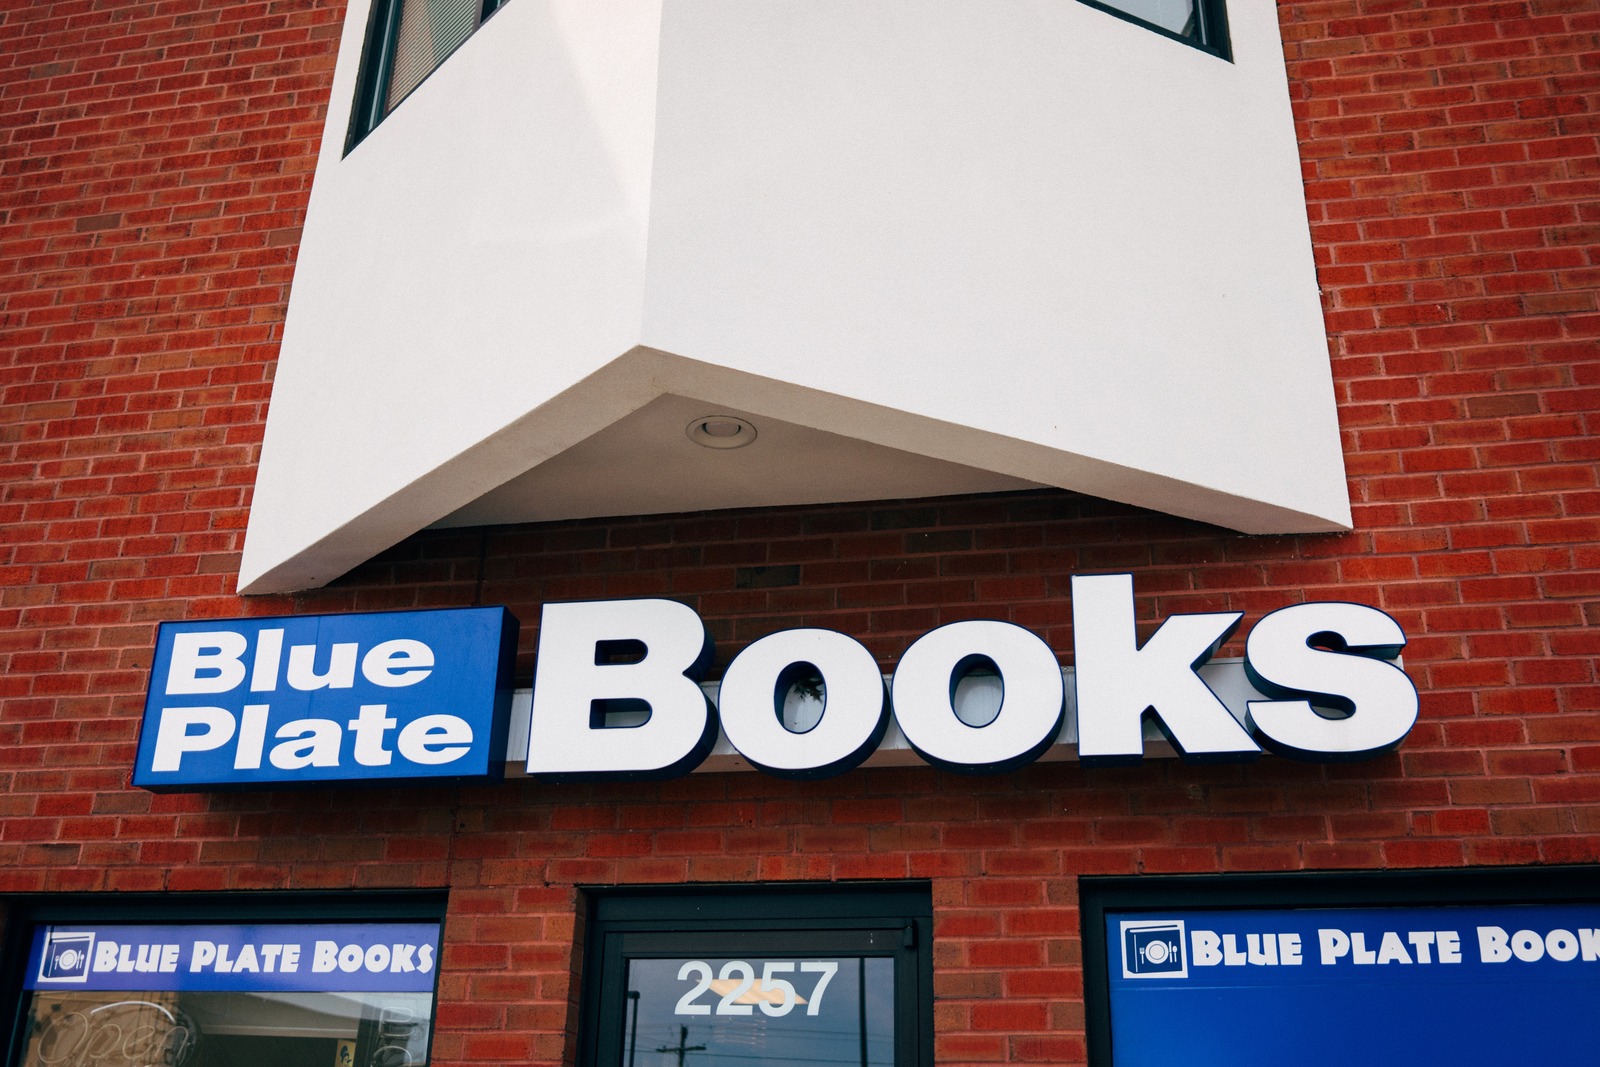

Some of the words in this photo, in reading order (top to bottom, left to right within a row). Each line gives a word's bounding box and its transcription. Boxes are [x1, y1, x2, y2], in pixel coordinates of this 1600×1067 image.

[165, 628, 435, 695] Blue
[526, 574, 1420, 774] Books
[151, 704, 474, 772] Plate
[674, 960, 839, 1018] 2257
